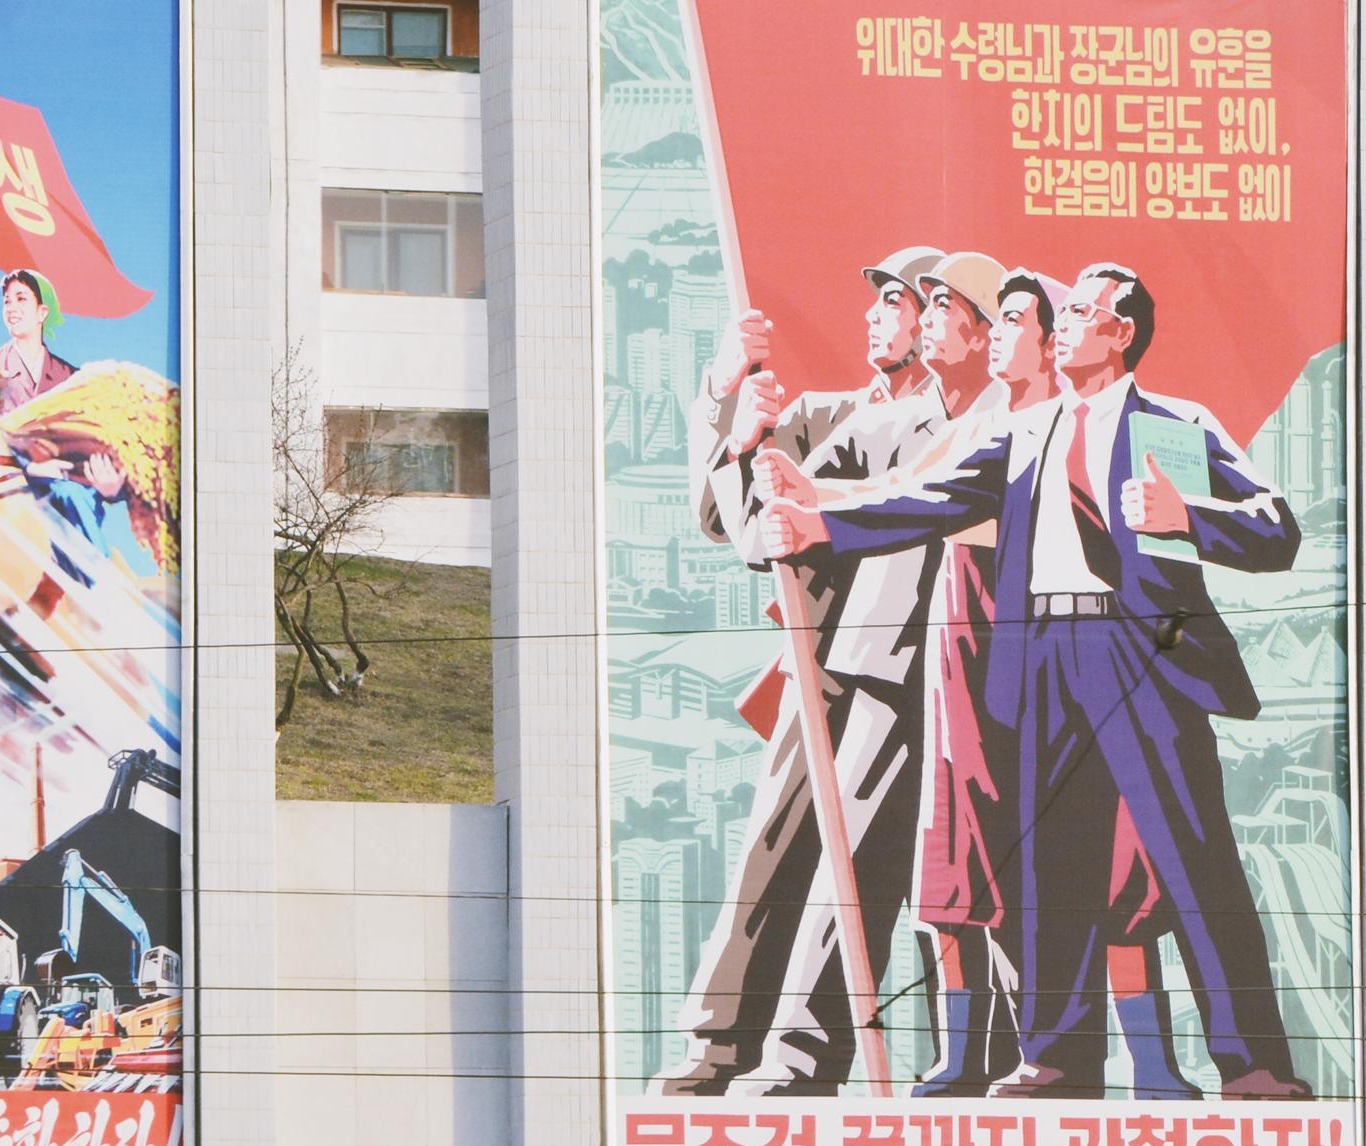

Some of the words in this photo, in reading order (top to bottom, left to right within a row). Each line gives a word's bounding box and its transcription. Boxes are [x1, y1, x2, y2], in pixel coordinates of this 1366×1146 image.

[856, 16, 945, 78] 위대한
[950, 22, 1065, 84] 수령님과
[1069, 25, 1179, 87] 장군님의
[1190, 28, 1271, 89] 유훈을
[1012, 88, 1102, 151] 한치의
[1116, 94, 1203, 154] 드팀도
[1218, 96, 1291, 156] 없이,
[1024, 155, 1137, 217] 한걸음의
[1145, 162, 1229, 220] 양보도
[1238, 163, 1291, 222] 없이
